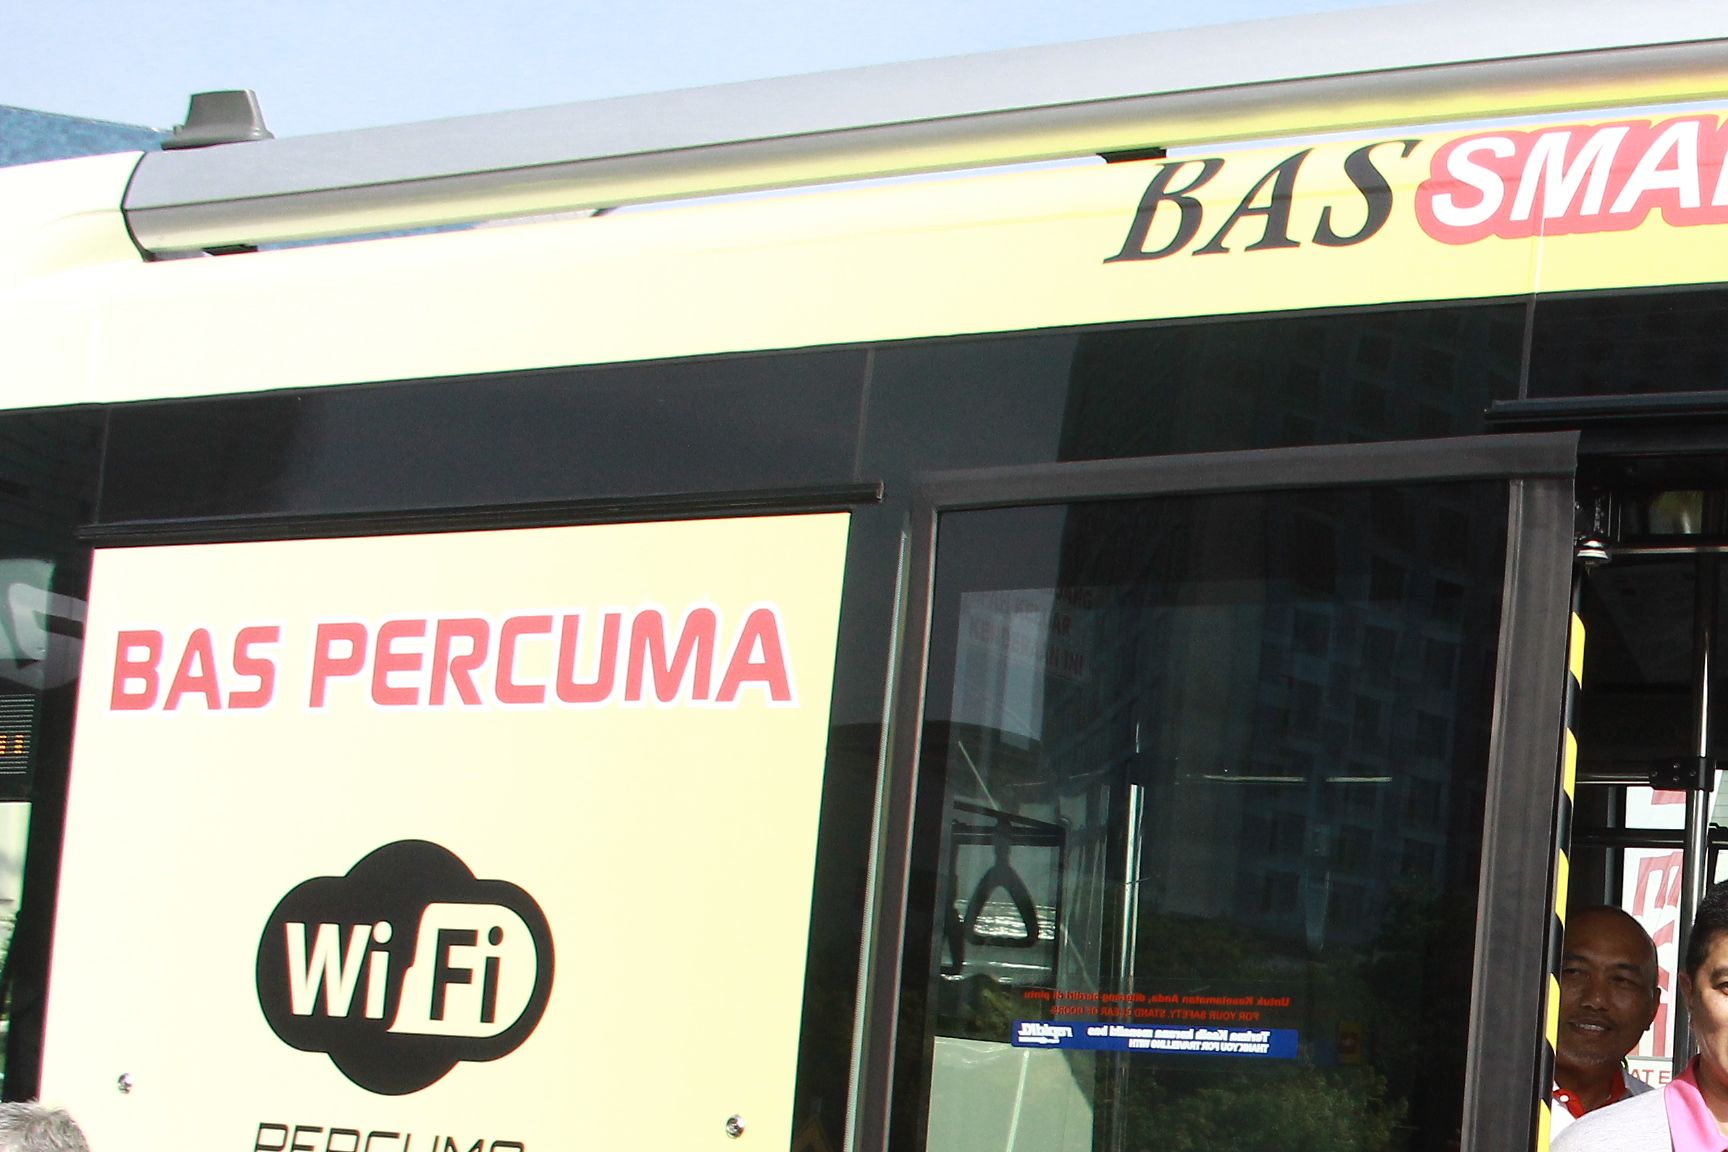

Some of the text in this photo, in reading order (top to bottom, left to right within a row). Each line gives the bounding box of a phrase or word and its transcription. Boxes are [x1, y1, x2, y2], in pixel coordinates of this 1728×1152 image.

[1103, 139, 1420, 264] BAS
[111, 607, 792, 711] BAS PERCUMA
